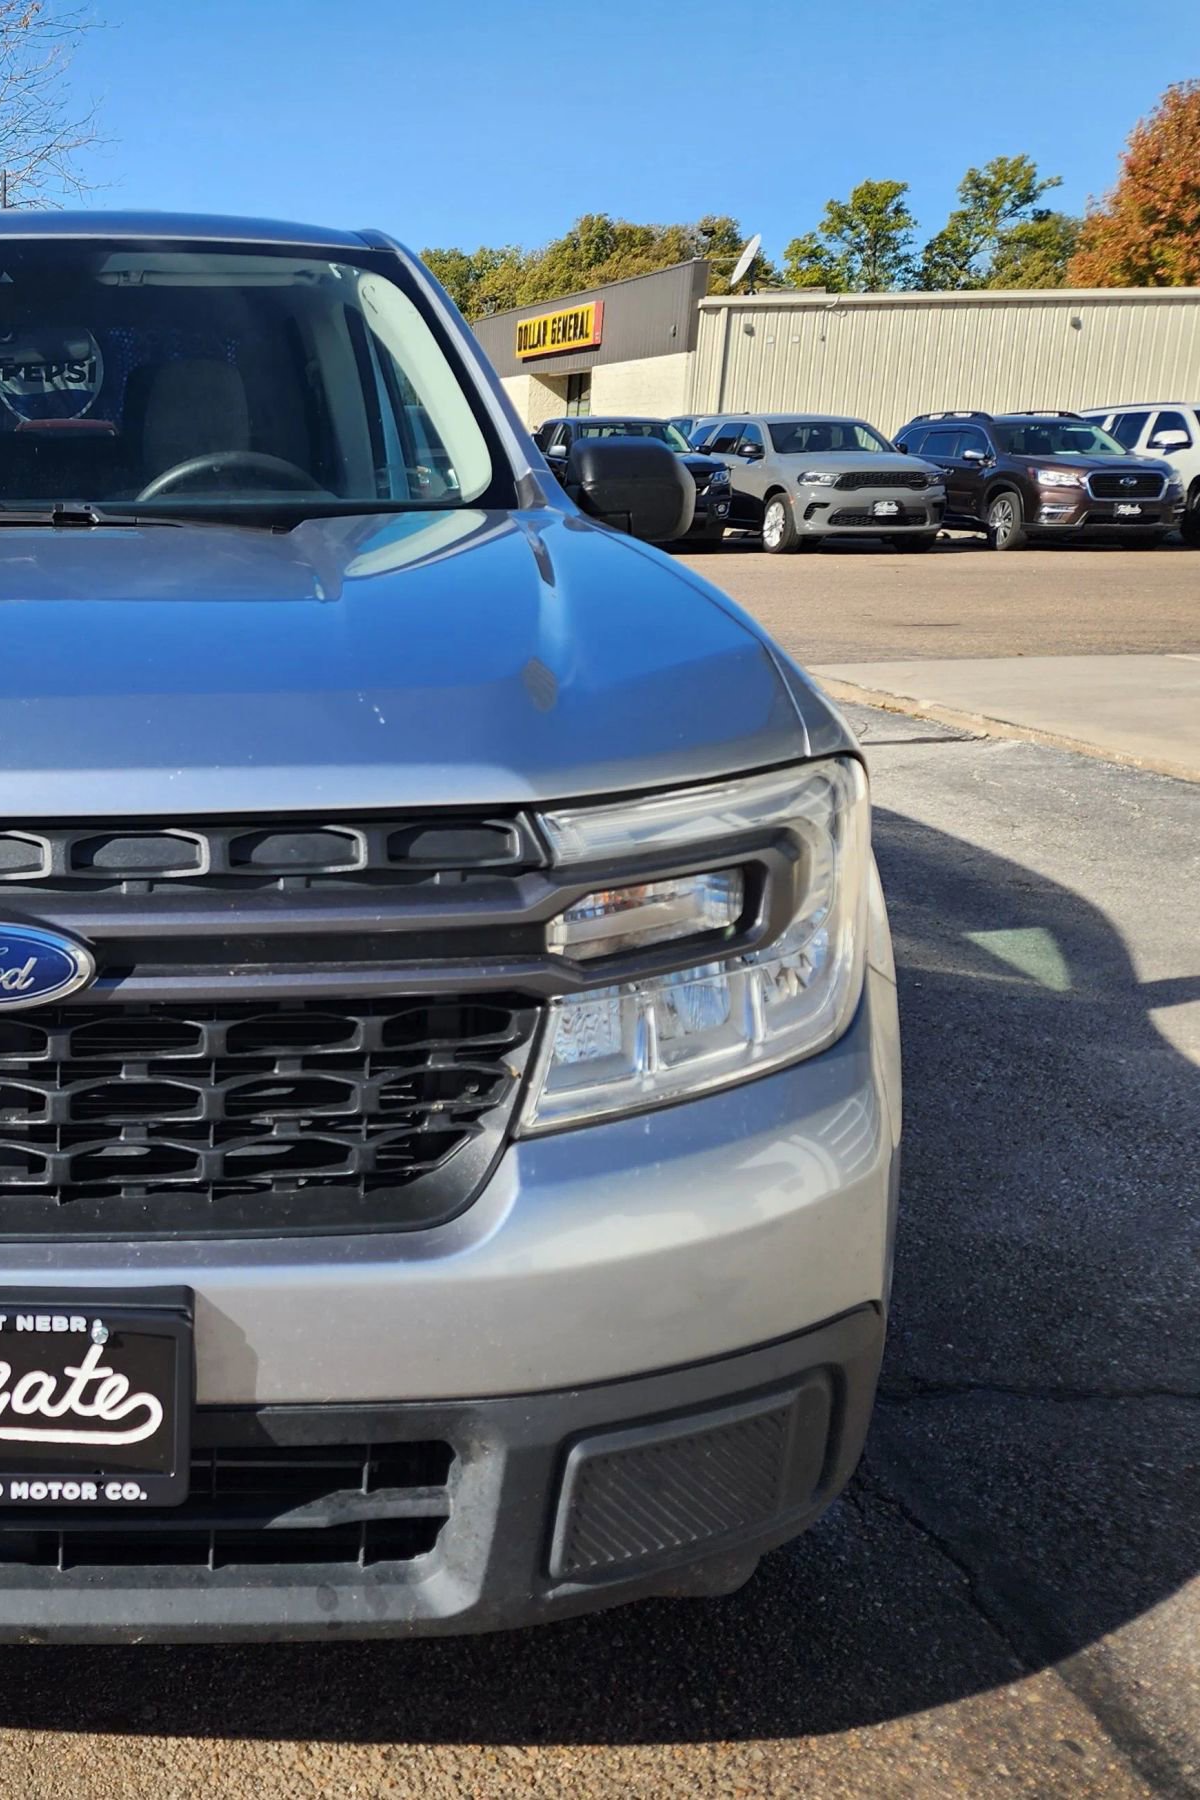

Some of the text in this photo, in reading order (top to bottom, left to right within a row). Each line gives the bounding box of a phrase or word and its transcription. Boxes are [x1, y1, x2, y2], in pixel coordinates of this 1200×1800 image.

[517, 309, 590, 353] DOLLAR GENERAL
[2, 360, 97, 384] PEPSI
[15, 1315, 87, 1332] NEBR
[10, 1481, 98, 1501] MOTOR
[104, 1481, 148, 1501] CO.
